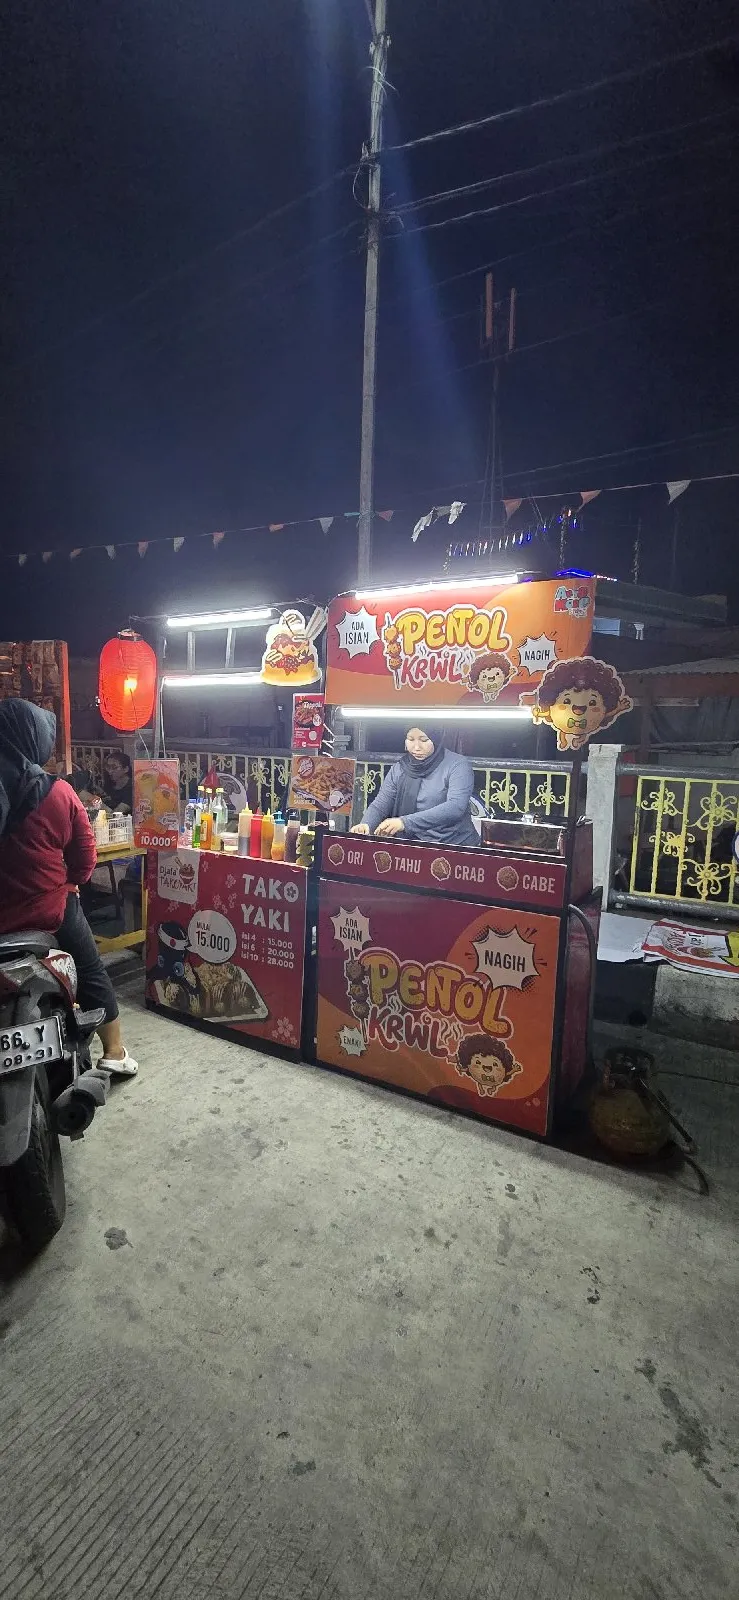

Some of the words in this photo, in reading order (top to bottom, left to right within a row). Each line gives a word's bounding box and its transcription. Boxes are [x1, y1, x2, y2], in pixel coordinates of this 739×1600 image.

[351, 621, 365, 631] ADA
[395, 607, 510, 655] PENTOL
[344, 631, 369, 646] ISIAN
[524, 649, 550, 662] NAGIH
[141, 836, 170, 847] 10.000
[347, 850, 364, 867] ORI
[394, 857, 421, 874] TAHU
[454, 865, 485, 883] CRAB
[522, 875, 556, 894] CABE
[241, 873, 299, 903] TAKO
[240, 903, 290, 933] YAKI
[345, 916, 358, 929] ADA
[195, 930, 230, 953] 15.000
[339, 926, 362, 943] ISIAN
[267, 938, 293, 950] 15.000
[250, 953, 259, 961] 10
[267, 957, 294, 969] 28.000
[267, 948, 295, 960] 20.000
[484, 952, 526, 973] NAGIH
[361, 954, 511, 1035] PENTOL
[35, 1025, 45, 1042] Y
